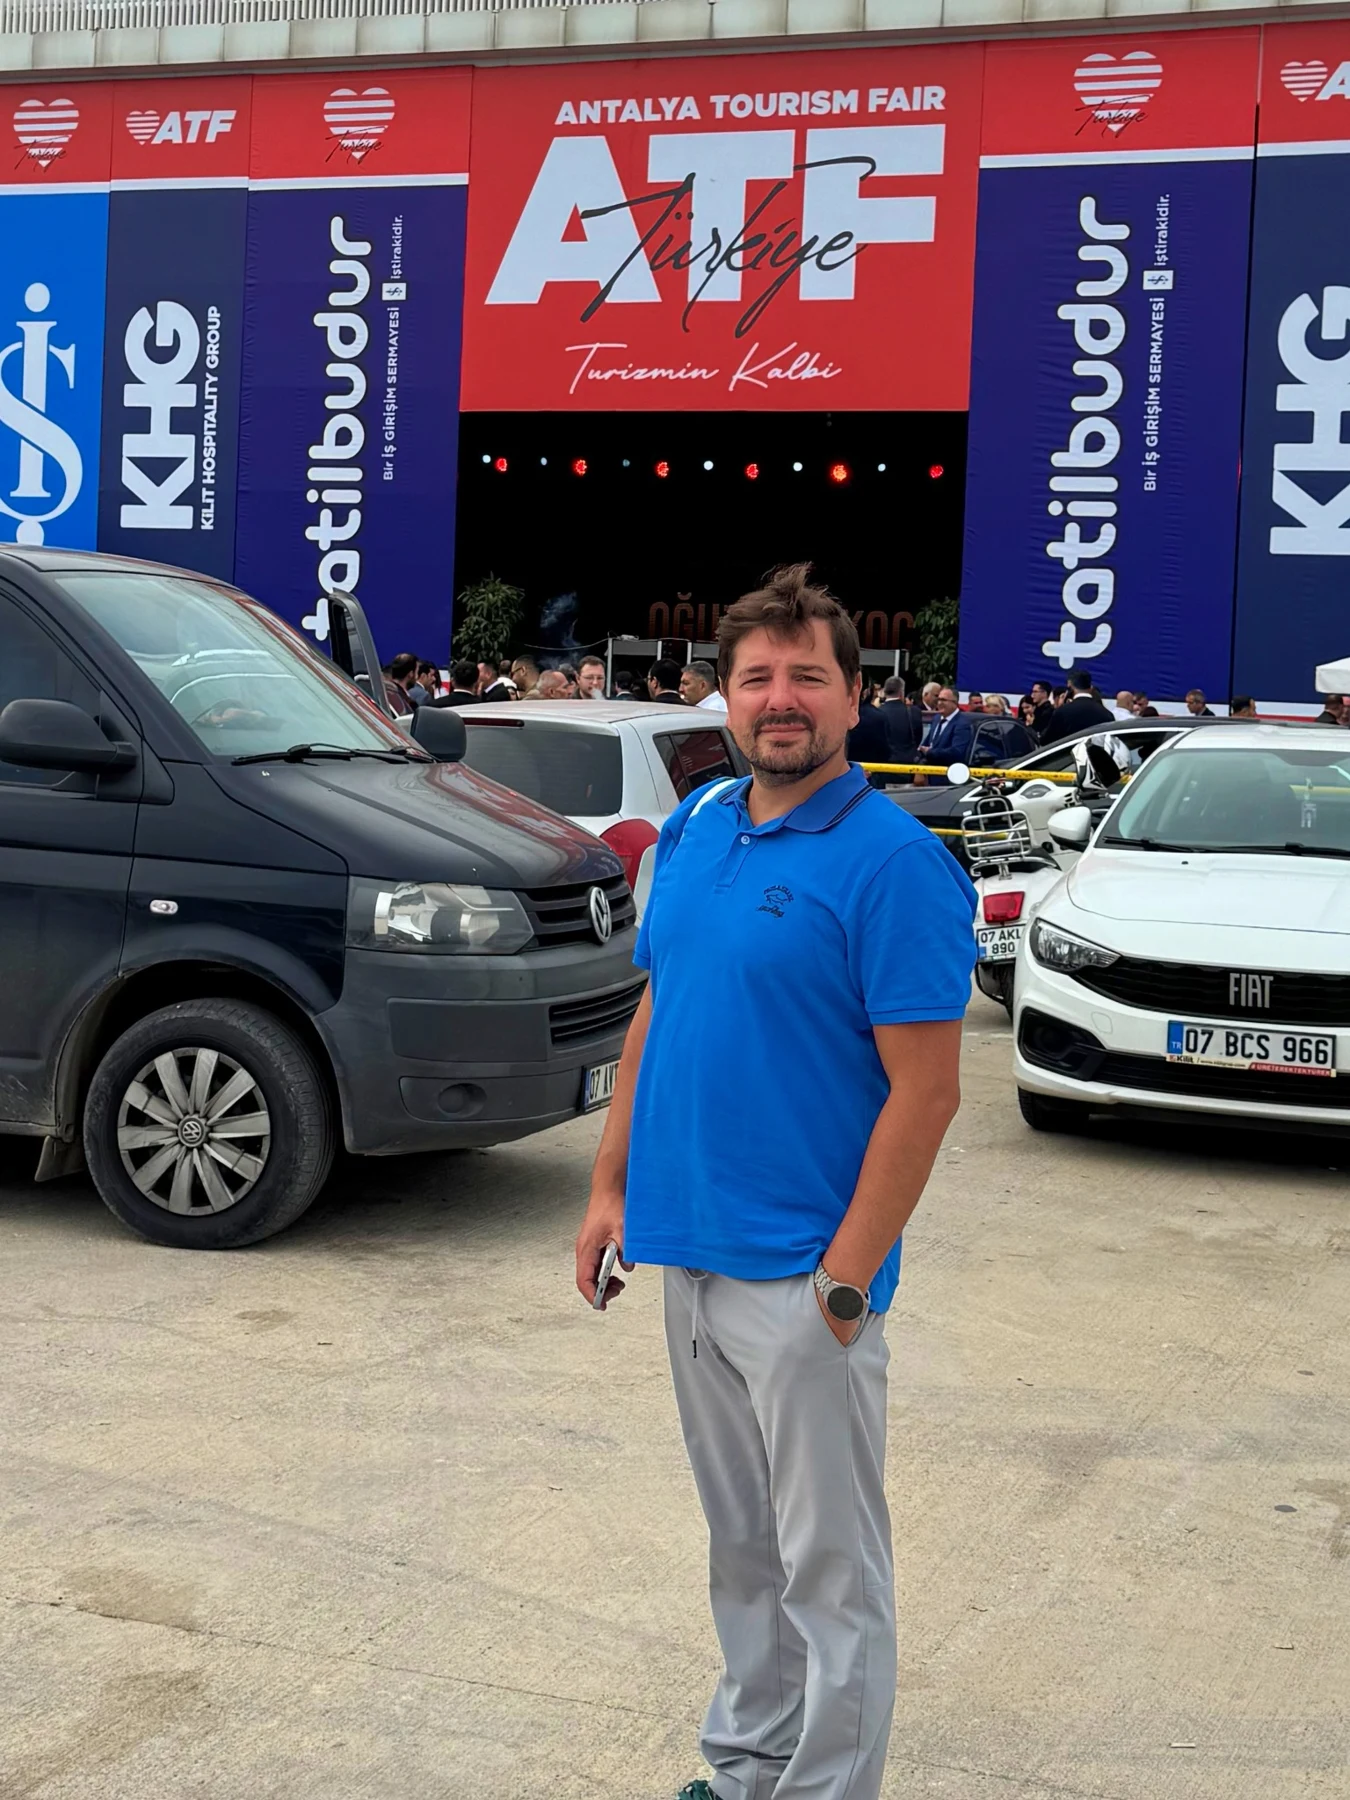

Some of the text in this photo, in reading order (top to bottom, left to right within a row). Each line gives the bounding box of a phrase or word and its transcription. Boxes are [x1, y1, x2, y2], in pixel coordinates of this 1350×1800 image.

[151, 110, 237, 144] ATF
[555, 86, 946, 125] ANTALYA TOURISM FAIR
[484, 124, 946, 305] ATF
[1155, 194, 1170, 266] iştirakidir.
[580, 155, 877, 338] Türkiye
[206, 305, 221, 369] GROUP
[387, 307, 400, 384] SERMAYESİ
[1149, 297, 1165, 383] SERMAYESİ
[565, 341, 842, 394] Turizmin Kalbi
[121, 301, 200, 529] KHG
[203, 372, 219, 484] HOSPITALITY
[383, 387, 398, 441] GİRİŞİM
[1042, 196, 1130, 669] tatilbudur
[1144, 387, 1162, 447] GİRİŞİM
[1269, 286, 1350, 556] KHG
[381, 444, 397, 458] İŞ
[383, 461, 393, 480] Bir
[1142, 451, 1160, 466] İŞ
[1144, 470, 1157, 491] Bir
[980, 928, 1021, 943] 07 AKL
[992, 942, 1015, 955] 890
[1229, 973, 1274, 1008] FIAT
[1172, 1028, 1329, 1065] TR 07 BCS 966
[590, 1068, 601, 1100] 07
